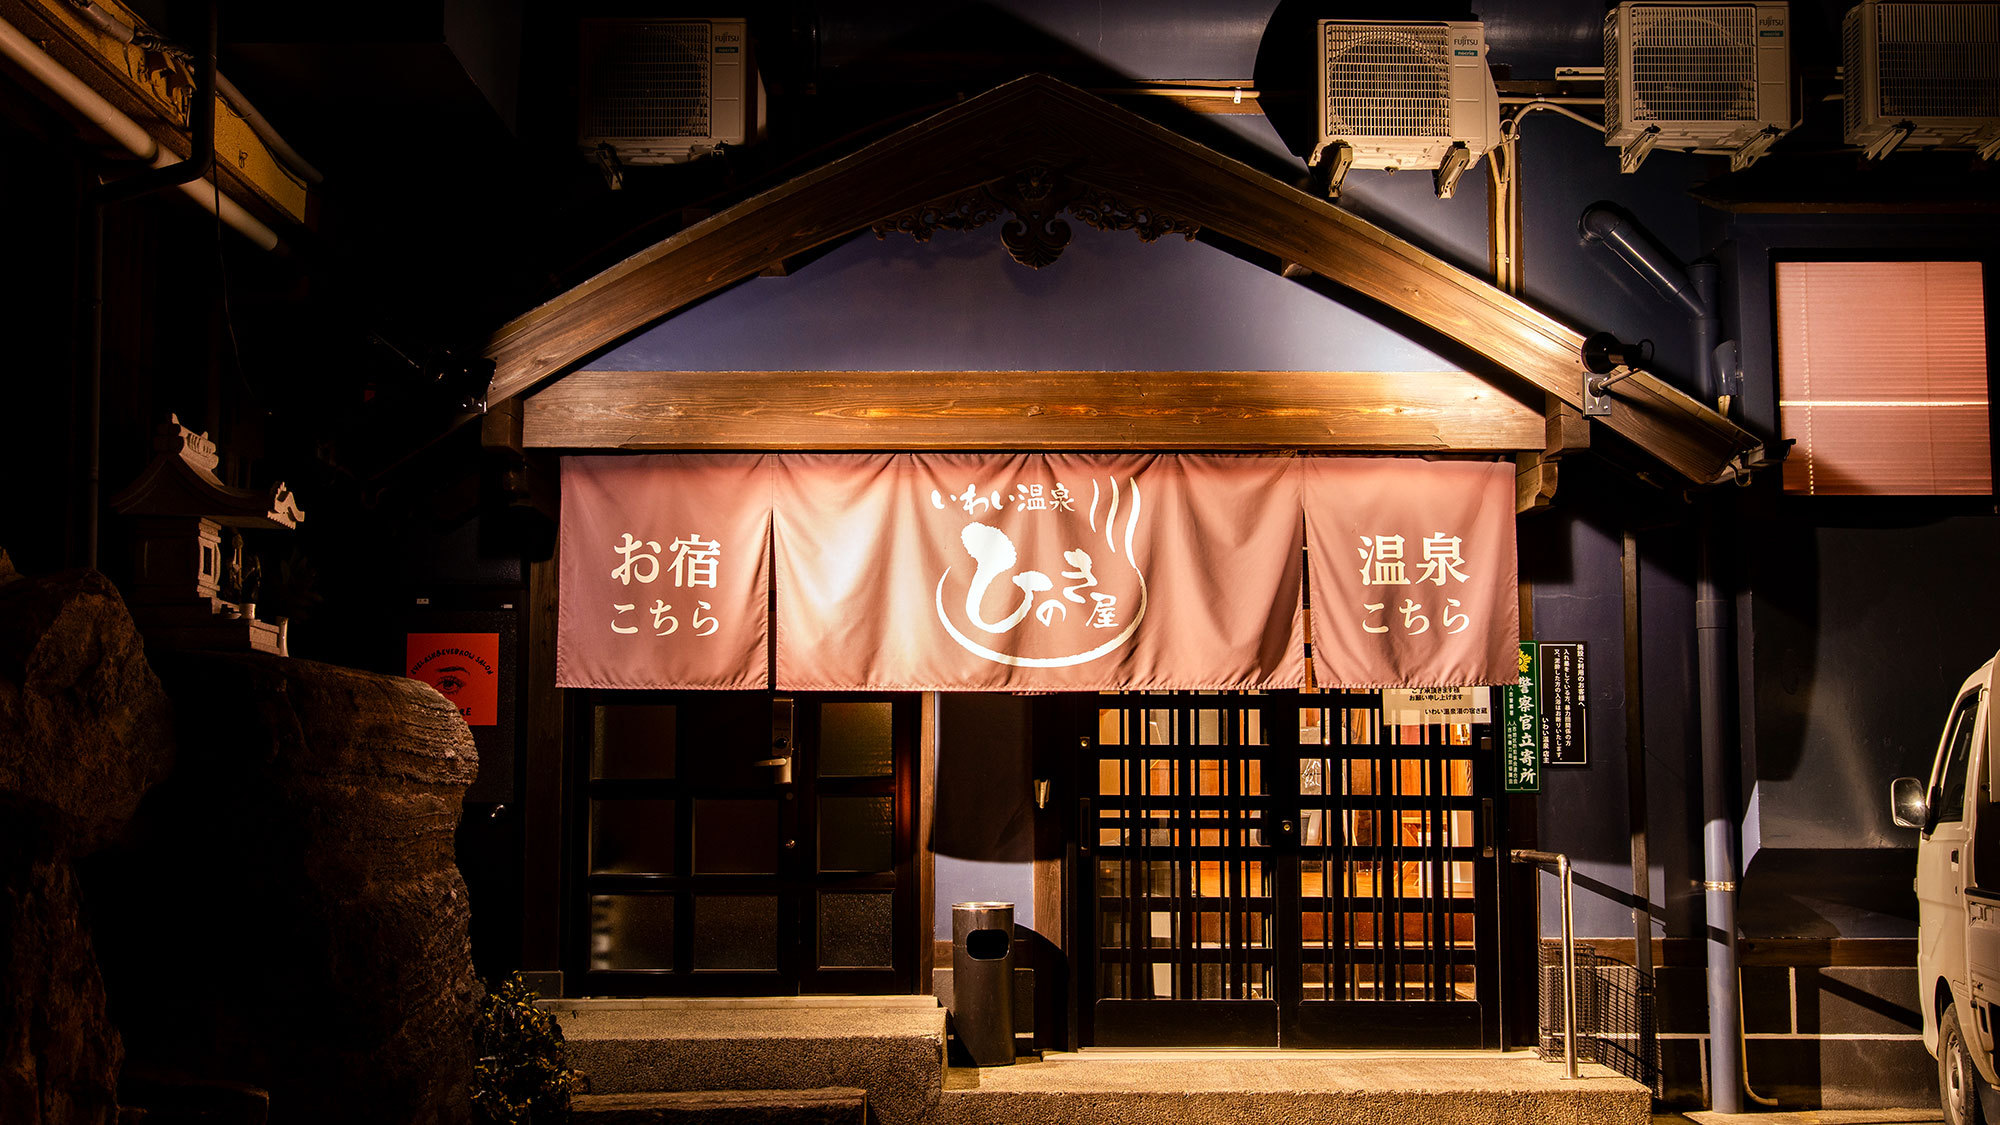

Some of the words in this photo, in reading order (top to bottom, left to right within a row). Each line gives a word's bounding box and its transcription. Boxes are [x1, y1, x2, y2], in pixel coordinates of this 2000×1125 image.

[715, 32, 739, 43] FUJITSU
[1759, 16, 1784, 28] FUJITSU
[1454, 35, 1478, 47] FUJITSU
[930, 482, 1075, 515] いわい温泉
[611, 533, 721, 589] お宿
[960, 521, 1119, 634] ひのき屋
[1358, 532, 1471, 586] 温泉
[610, 600, 721, 637] こちら
[1362, 598, 1471, 635] こちら
[475, 656, 494, 675] SALON
[1577, 643, 1586, 707] 施設ご利用のお客様へ
[1518, 675, 1537, 785] 警察官立寄所
